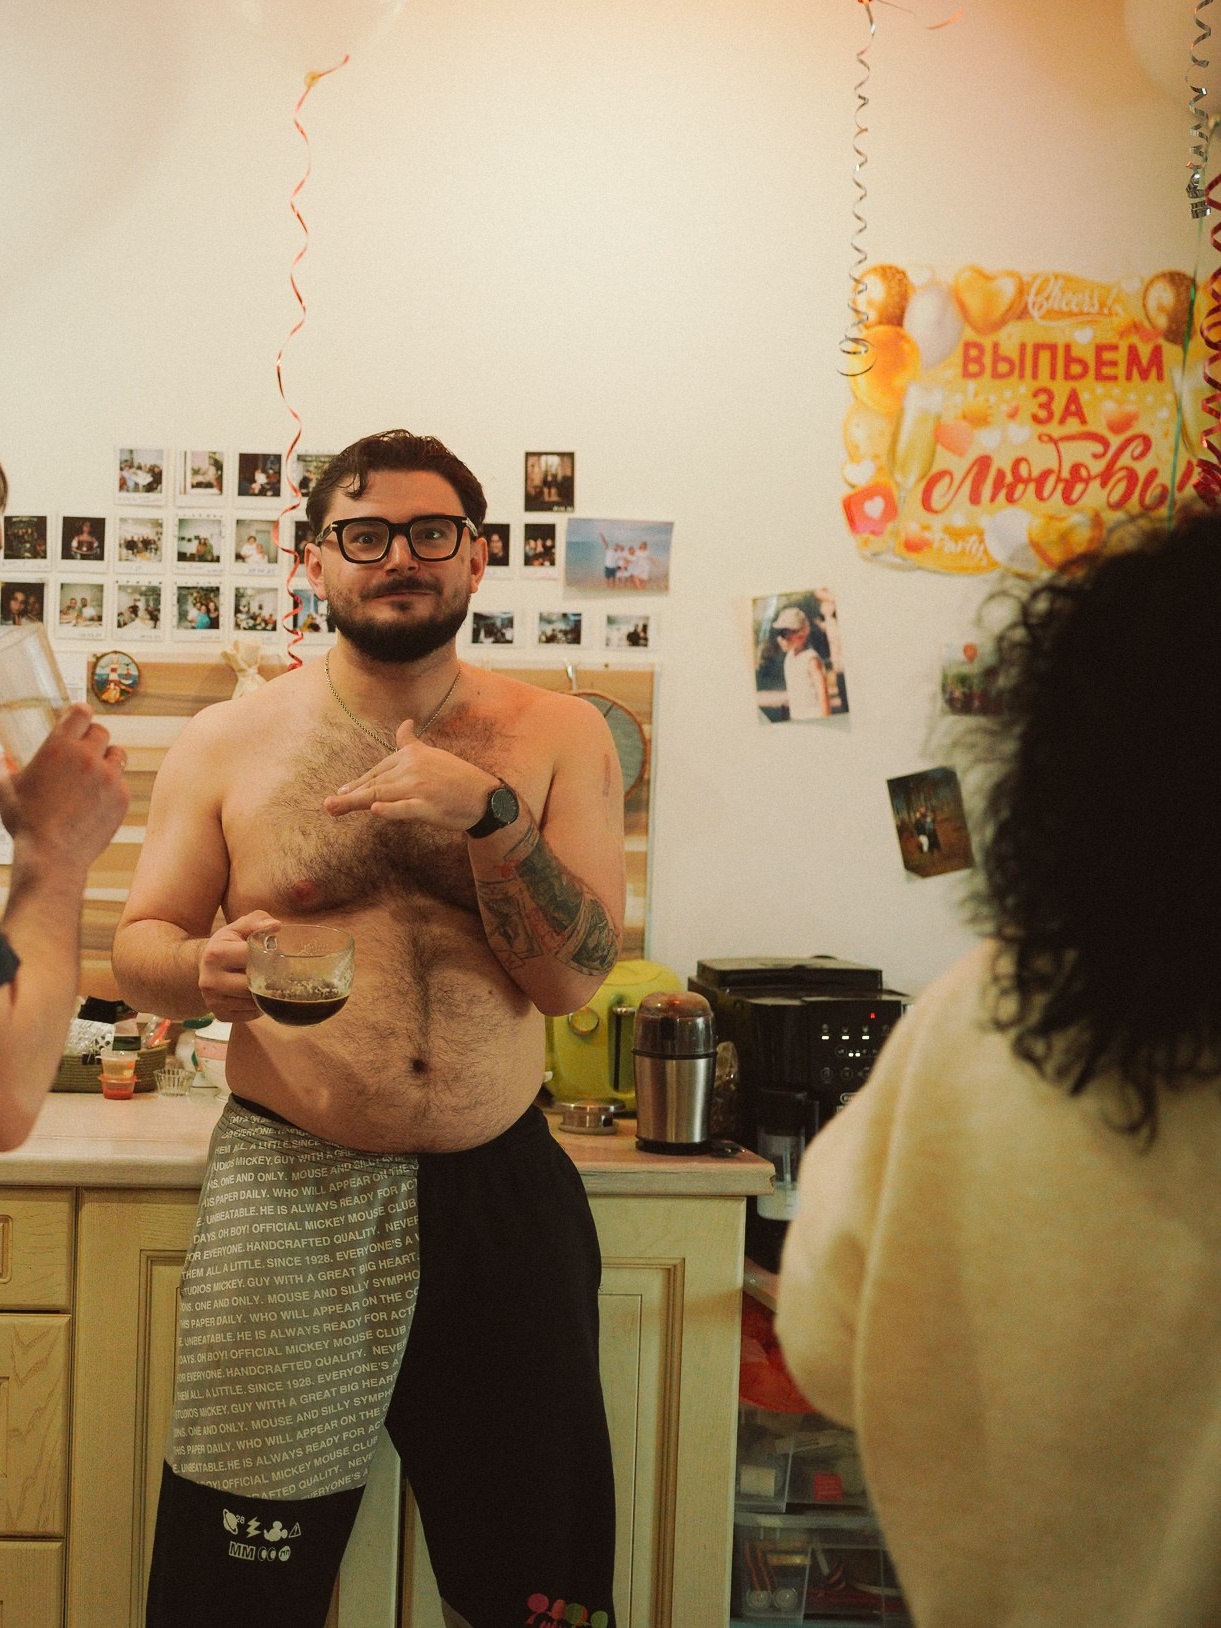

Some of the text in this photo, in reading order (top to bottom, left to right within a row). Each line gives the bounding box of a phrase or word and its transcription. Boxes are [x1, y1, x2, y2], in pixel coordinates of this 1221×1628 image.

[962, 341, 1164, 382] ВЫПЬЕМ
[1031, 387, 1088, 426] ЗА
[221, 1175, 234, 1186] ONE
[236, 1172, 254, 1182] AND
[258, 1171, 287, 1181] ONLY.
[292, 1167, 328, 1181] MOUSE
[236, 1156, 273, 1165] MICKEY.
[274, 1156, 295, 1164] GUY
[216, 1192, 238, 1205] PAPER
[240, 1189, 269, 1199] DAILY.
[273, 1188, 299, 1197] WHO
[302, 1186, 326, 1196] WILL
[329, 1175, 371, 1193] APPEAR
[373, 1172, 388, 1181] ON
[388, 1164, 410, 1177] THE
[206, 1206, 258, 1225] UNBEATABLE.
[261, 1206, 274, 1215] HE
[277, 1205, 288, 1214] IS
[291, 1200, 338, 1214] ALWAYS
[340, 1192, 374, 1208] READY
[377, 1185, 398, 1199] FOR
[218, 1229, 229, 1239] OH
[230, 1224, 250, 1236] BOY!
[252, 1221, 302, 1233] OFFICIAL
[305, 1216, 345, 1230] MICKEY
[348, 1206, 385, 1223] MOUSE
[387, 1198, 417, 1214] CLUB
[182, 1268, 203, 1281] THEM
[223, 1264, 228, 1272] A
[230, 1260, 264, 1272] LITTLE.
[267, 1257, 302, 1268] SINCE
[305, 1254, 333, 1265] 1928.
[335, 1239, 402, 1261] EVERYONE'S
[405, 1235, 413, 1246] A
[203, 1243, 245, 1260] EVERYONE.
[246, 1236, 330, 1252] HANDCRAFTED
[334, 1226, 380, 1244] QUALITY.
[212, 1279, 245, 1292] MICKEY.
[247, 1277, 270, 1287] GUY
[274, 1274, 303, 1285] WITH
[307, 1274, 315, 1283] A
[318, 1267, 356, 1281] GREAT
[360, 1261, 376, 1275] BIG
[379, 1252, 419, 1270] HEART.
[191, 1317, 215, 1328] PAPER
[216, 1314, 246, 1325] DAILY.
[249, 1312, 277, 1322] WHO
[280, 1308, 310, 1320] WILL
[313, 1301, 360, 1317] APPEAR
[362, 1296, 378, 1307] ON
[379, 1292, 402, 1304] THE
[195, 1301, 212, 1311] ONE
[213, 1298, 229, 1309] AND
[232, 1295, 264, 1306] ONLY.
[267, 1291, 310, 1304] MOUSE
[313, 1287, 338, 1300] AND
[340, 1280, 370, 1296] SILLY
[185, 1332, 235, 1347] UNBEATABLE.
[237, 1331, 252, 1341] HE
[255, 1330, 266, 1340] IS
[270, 1324, 320, 1338] ALWAYS
[323, 1317, 362, 1332] READY
[364, 1311, 388, 1323] FOR
[197, 1353, 206, 1363] OH
[207, 1350, 228, 1362] BOY!
[230, 1346, 283, 1359] OFFICIAL
[285, 1340, 330, 1355] MICKEY
[333, 1330, 373, 1347] MOUSE
[376, 1325, 406, 1338] CLUB
[187, 1369, 225, 1382] EVERYONE.
[226, 1360, 312, 1377] HANDCRAFTED
[315, 1349, 366, 1367] QUALITY.
[206, 1389, 211, 1398] A
[212, 1385, 246, 1397] LITTLE.
[248, 1382, 284, 1393] SINCE
[287, 1377, 315, 1388] 1928.
[317, 1361, 389, 1383] EVERYONE'S
[393, 1359, 399, 1367] A
[188, 1427, 201, 1436] ONE
[203, 1425, 218, 1435] AND
[220, 1422, 248, 1433] ONLY.
[251, 1415, 293, 1430] MOUSE
[296, 1410, 319, 1422] AND
[321, 1400, 350, 1416] SILLY
[200, 1405, 229, 1417] MICKEY.
[231, 1402, 253, 1414] GUY
[256, 1399, 286, 1410] WITH
[289, 1398, 297, 1406] A
[300, 1387, 337, 1404] GREAT
[340, 1382, 359, 1394] BIG
[181, 1462, 227, 1473] UNBEATABLE.
[228, 1460, 240, 1470] HE
[243, 1458, 253, 1467] IS
[256, 1449, 303, 1466] ALWAYS
[306, 1434, 340, 1454] READY
[342, 1427, 365, 1440] FOR
[187, 1444, 205, 1455] PAPER
[207, 1442, 234, 1454] DAILY.
[236, 1439, 262, 1450] WHO
[265, 1433, 294, 1446] WILL
[296, 1420, 338, 1440] APPEAR
[340, 1414, 356, 1425] ON
[359, 1408, 380, 1420] THE
[223, 1474, 269, 1490] OFFICIAL
[271, 1462, 312, 1481] MICKEY
[314, 1447, 350, 1467] MOUSE
[298, 1465, 342, 1489] QUALITY.
[229, 1542, 255, 1560] MM
